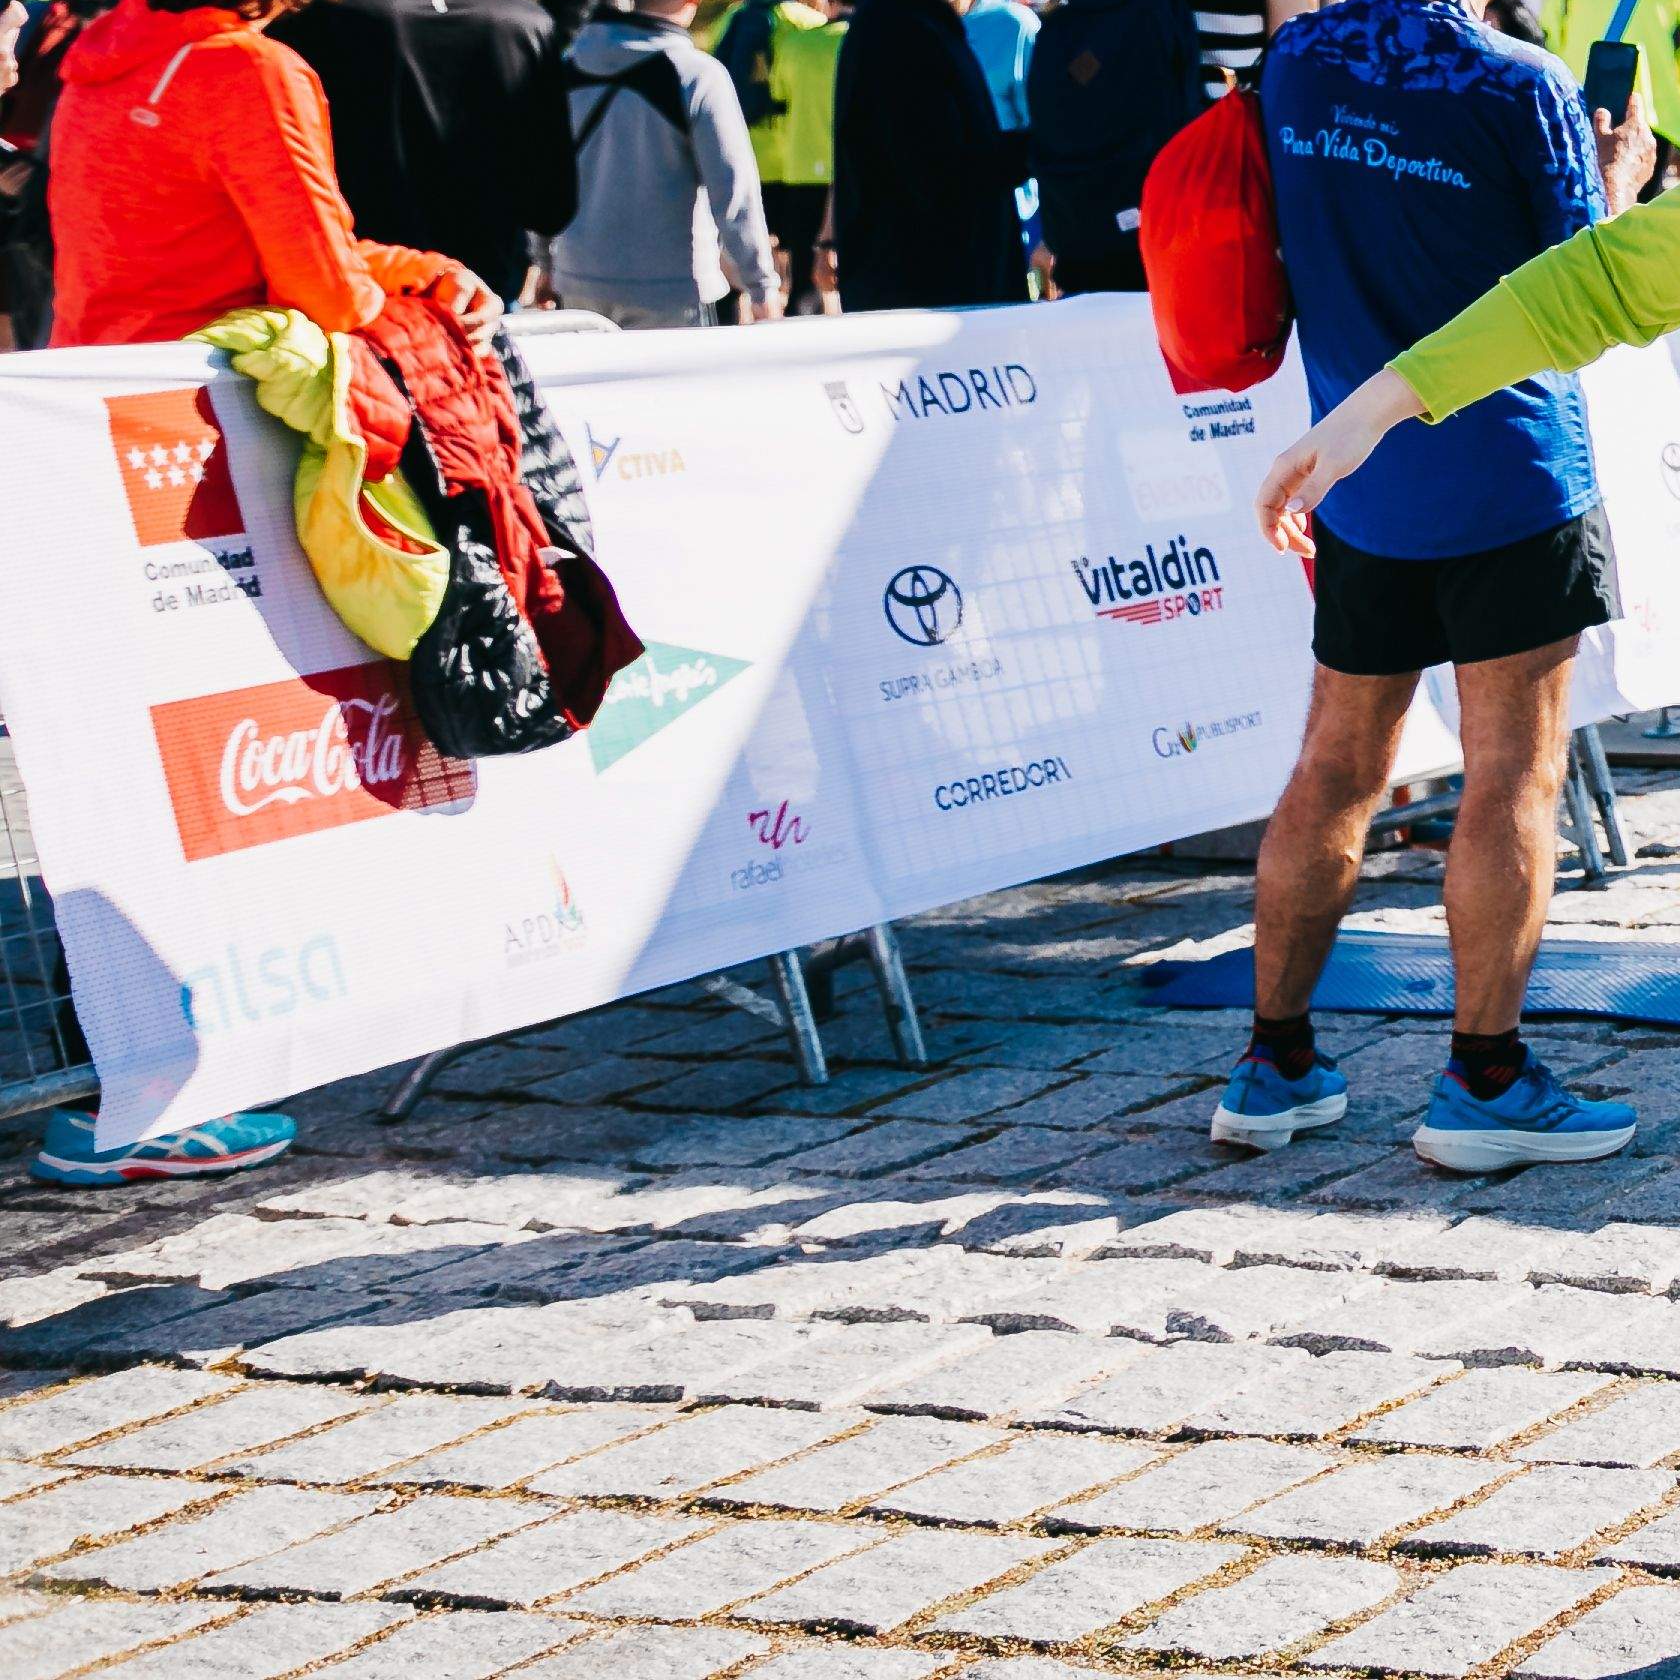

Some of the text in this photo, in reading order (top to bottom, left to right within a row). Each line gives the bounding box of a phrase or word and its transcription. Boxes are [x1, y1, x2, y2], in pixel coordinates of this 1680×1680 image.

[1316, 128, 1360, 161] Vida
[1363, 138, 1471, 190] Deportiva
[880, 364, 1038, 421] MADRID
[1183, 397, 1252, 419] Comunidad
[1188, 417, 1256, 442] de Madrid
[1071, 534, 1220, 606] Vitaldin
[152, 589, 179, 613] de
[1163, 586, 1224, 620] SPORT
[220, 692, 403, 816] Coca-Cola
[180, 932, 348, 1036] alsa
